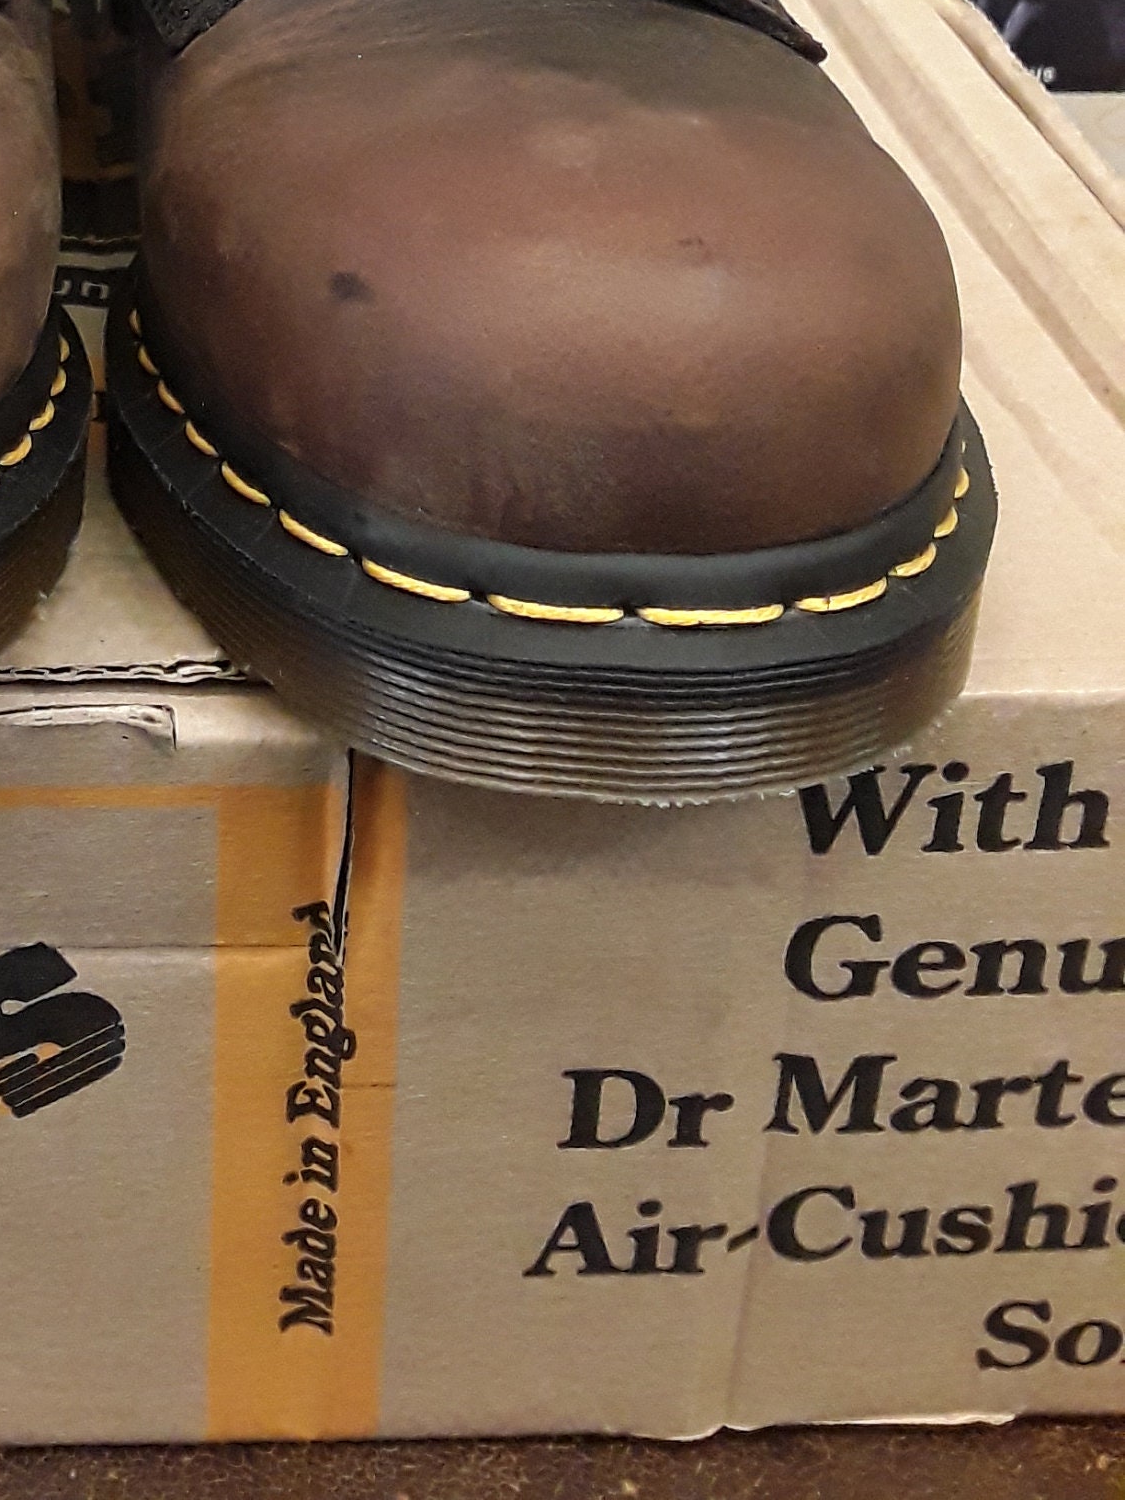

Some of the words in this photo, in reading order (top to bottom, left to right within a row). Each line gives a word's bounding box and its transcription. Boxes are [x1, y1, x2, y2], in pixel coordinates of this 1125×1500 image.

[796, 760, 1110, 857] With
[284, 898, 357, 1130] England
[555, 1068, 735, 1150] Dr
[281, 1133, 339, 1194] in
[277, 1196, 338, 1338] Made
[521, 1176, 1125, 1279] Air-Cushi
[976, 1300, 1125, 1371] So
